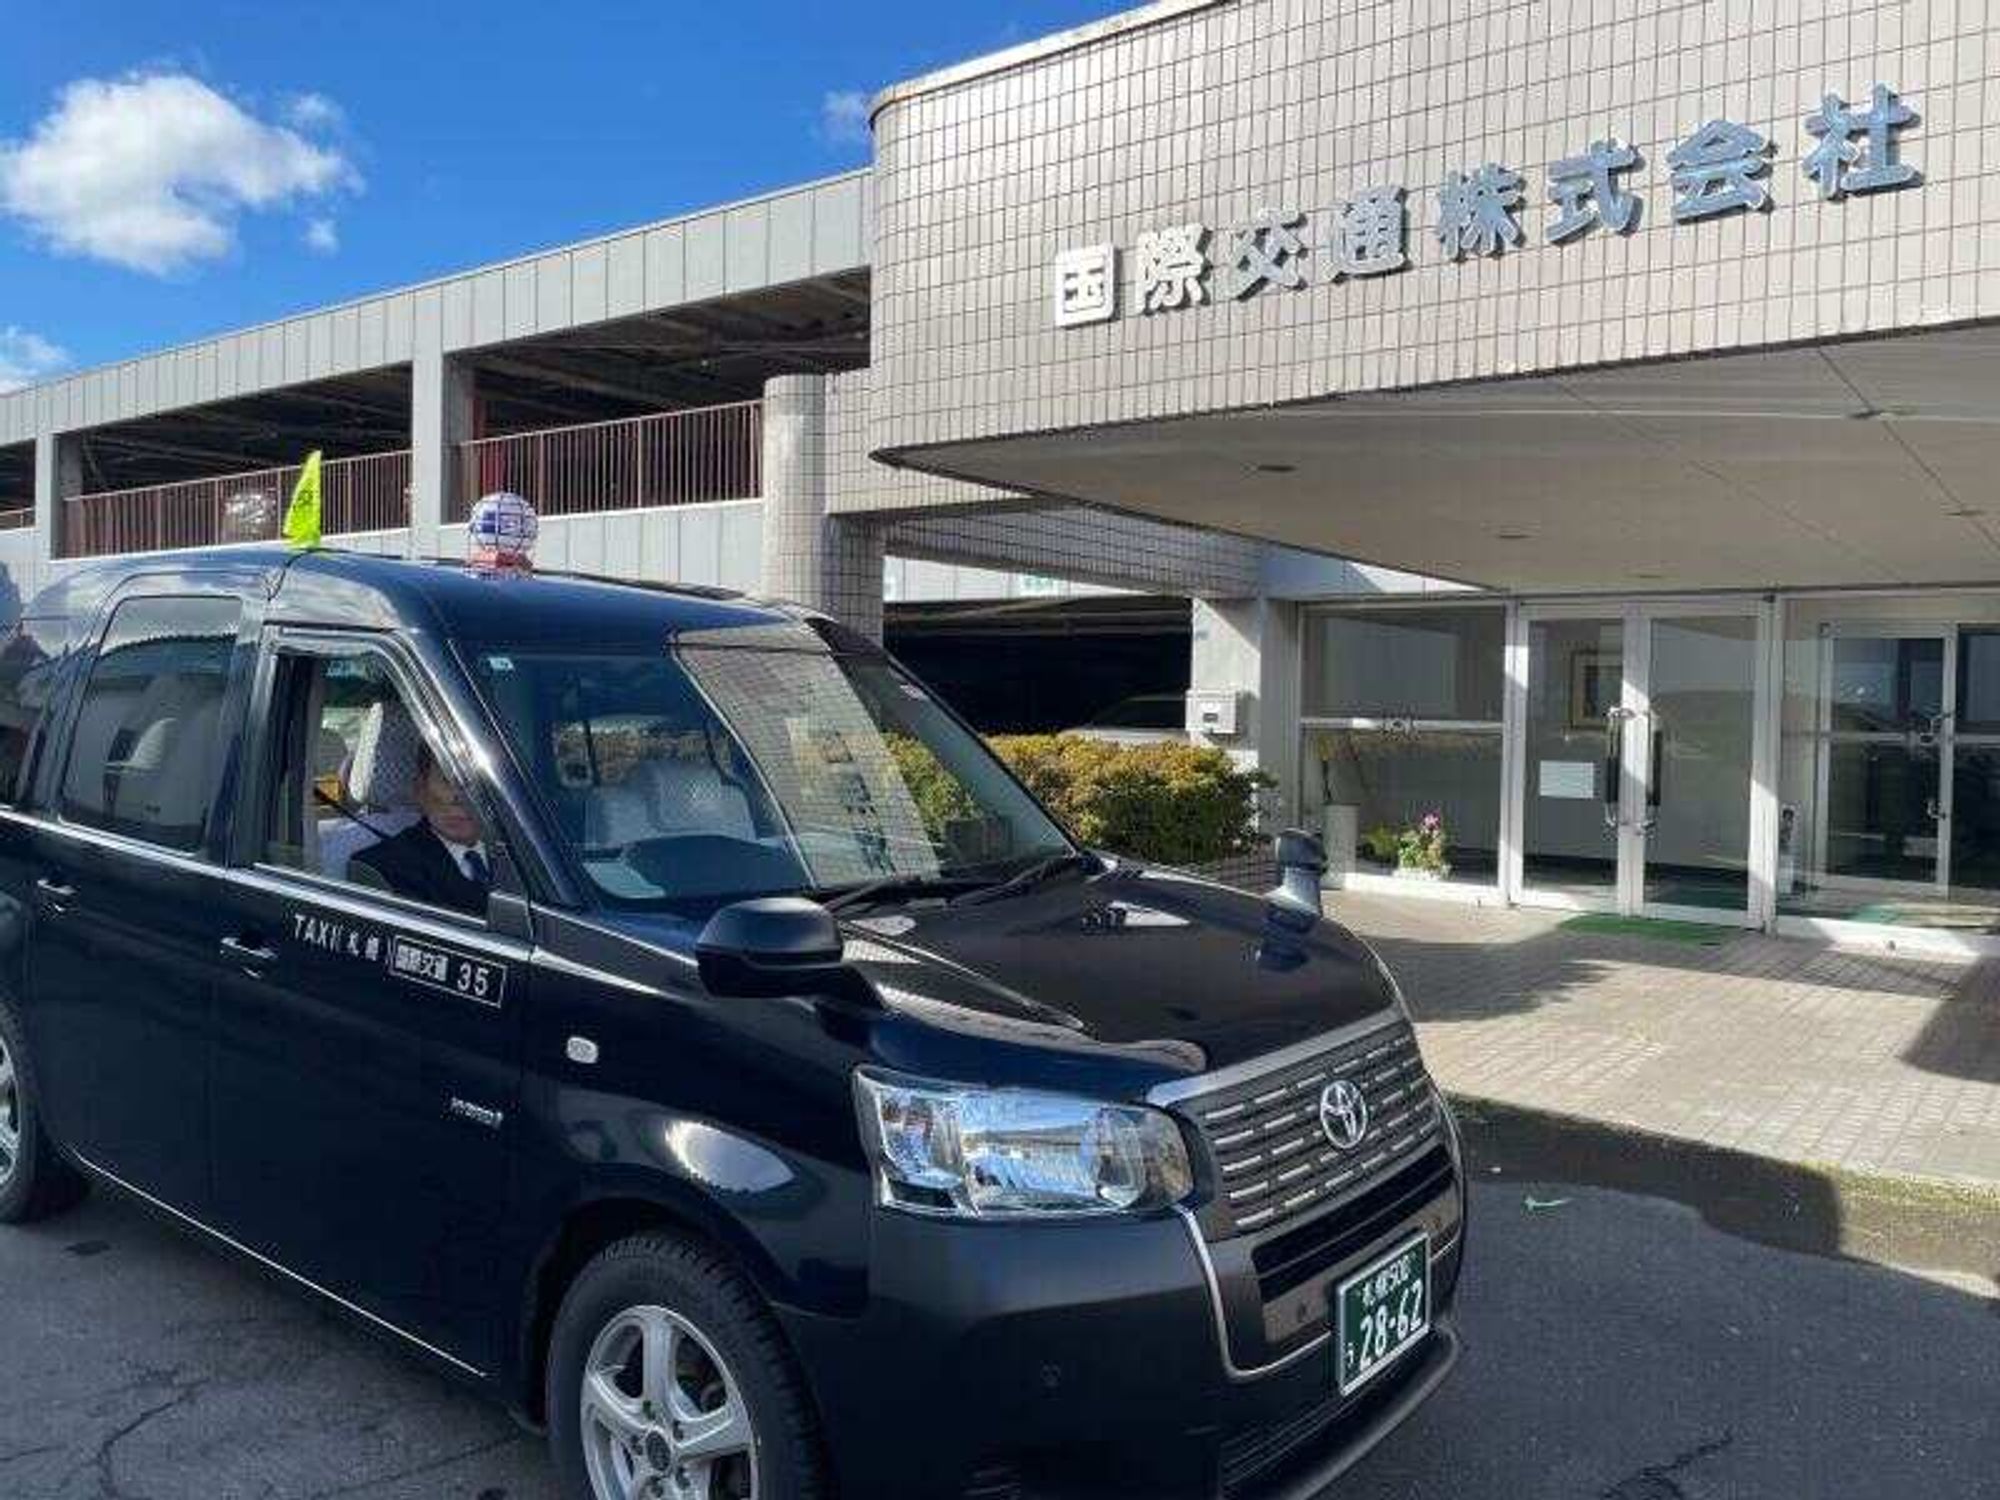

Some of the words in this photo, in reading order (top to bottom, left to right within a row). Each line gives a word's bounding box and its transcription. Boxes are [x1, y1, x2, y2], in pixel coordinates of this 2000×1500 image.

[1053, 84, 1921, 329] 国際交通株式会社
[457, 962, 489, 996] 35
